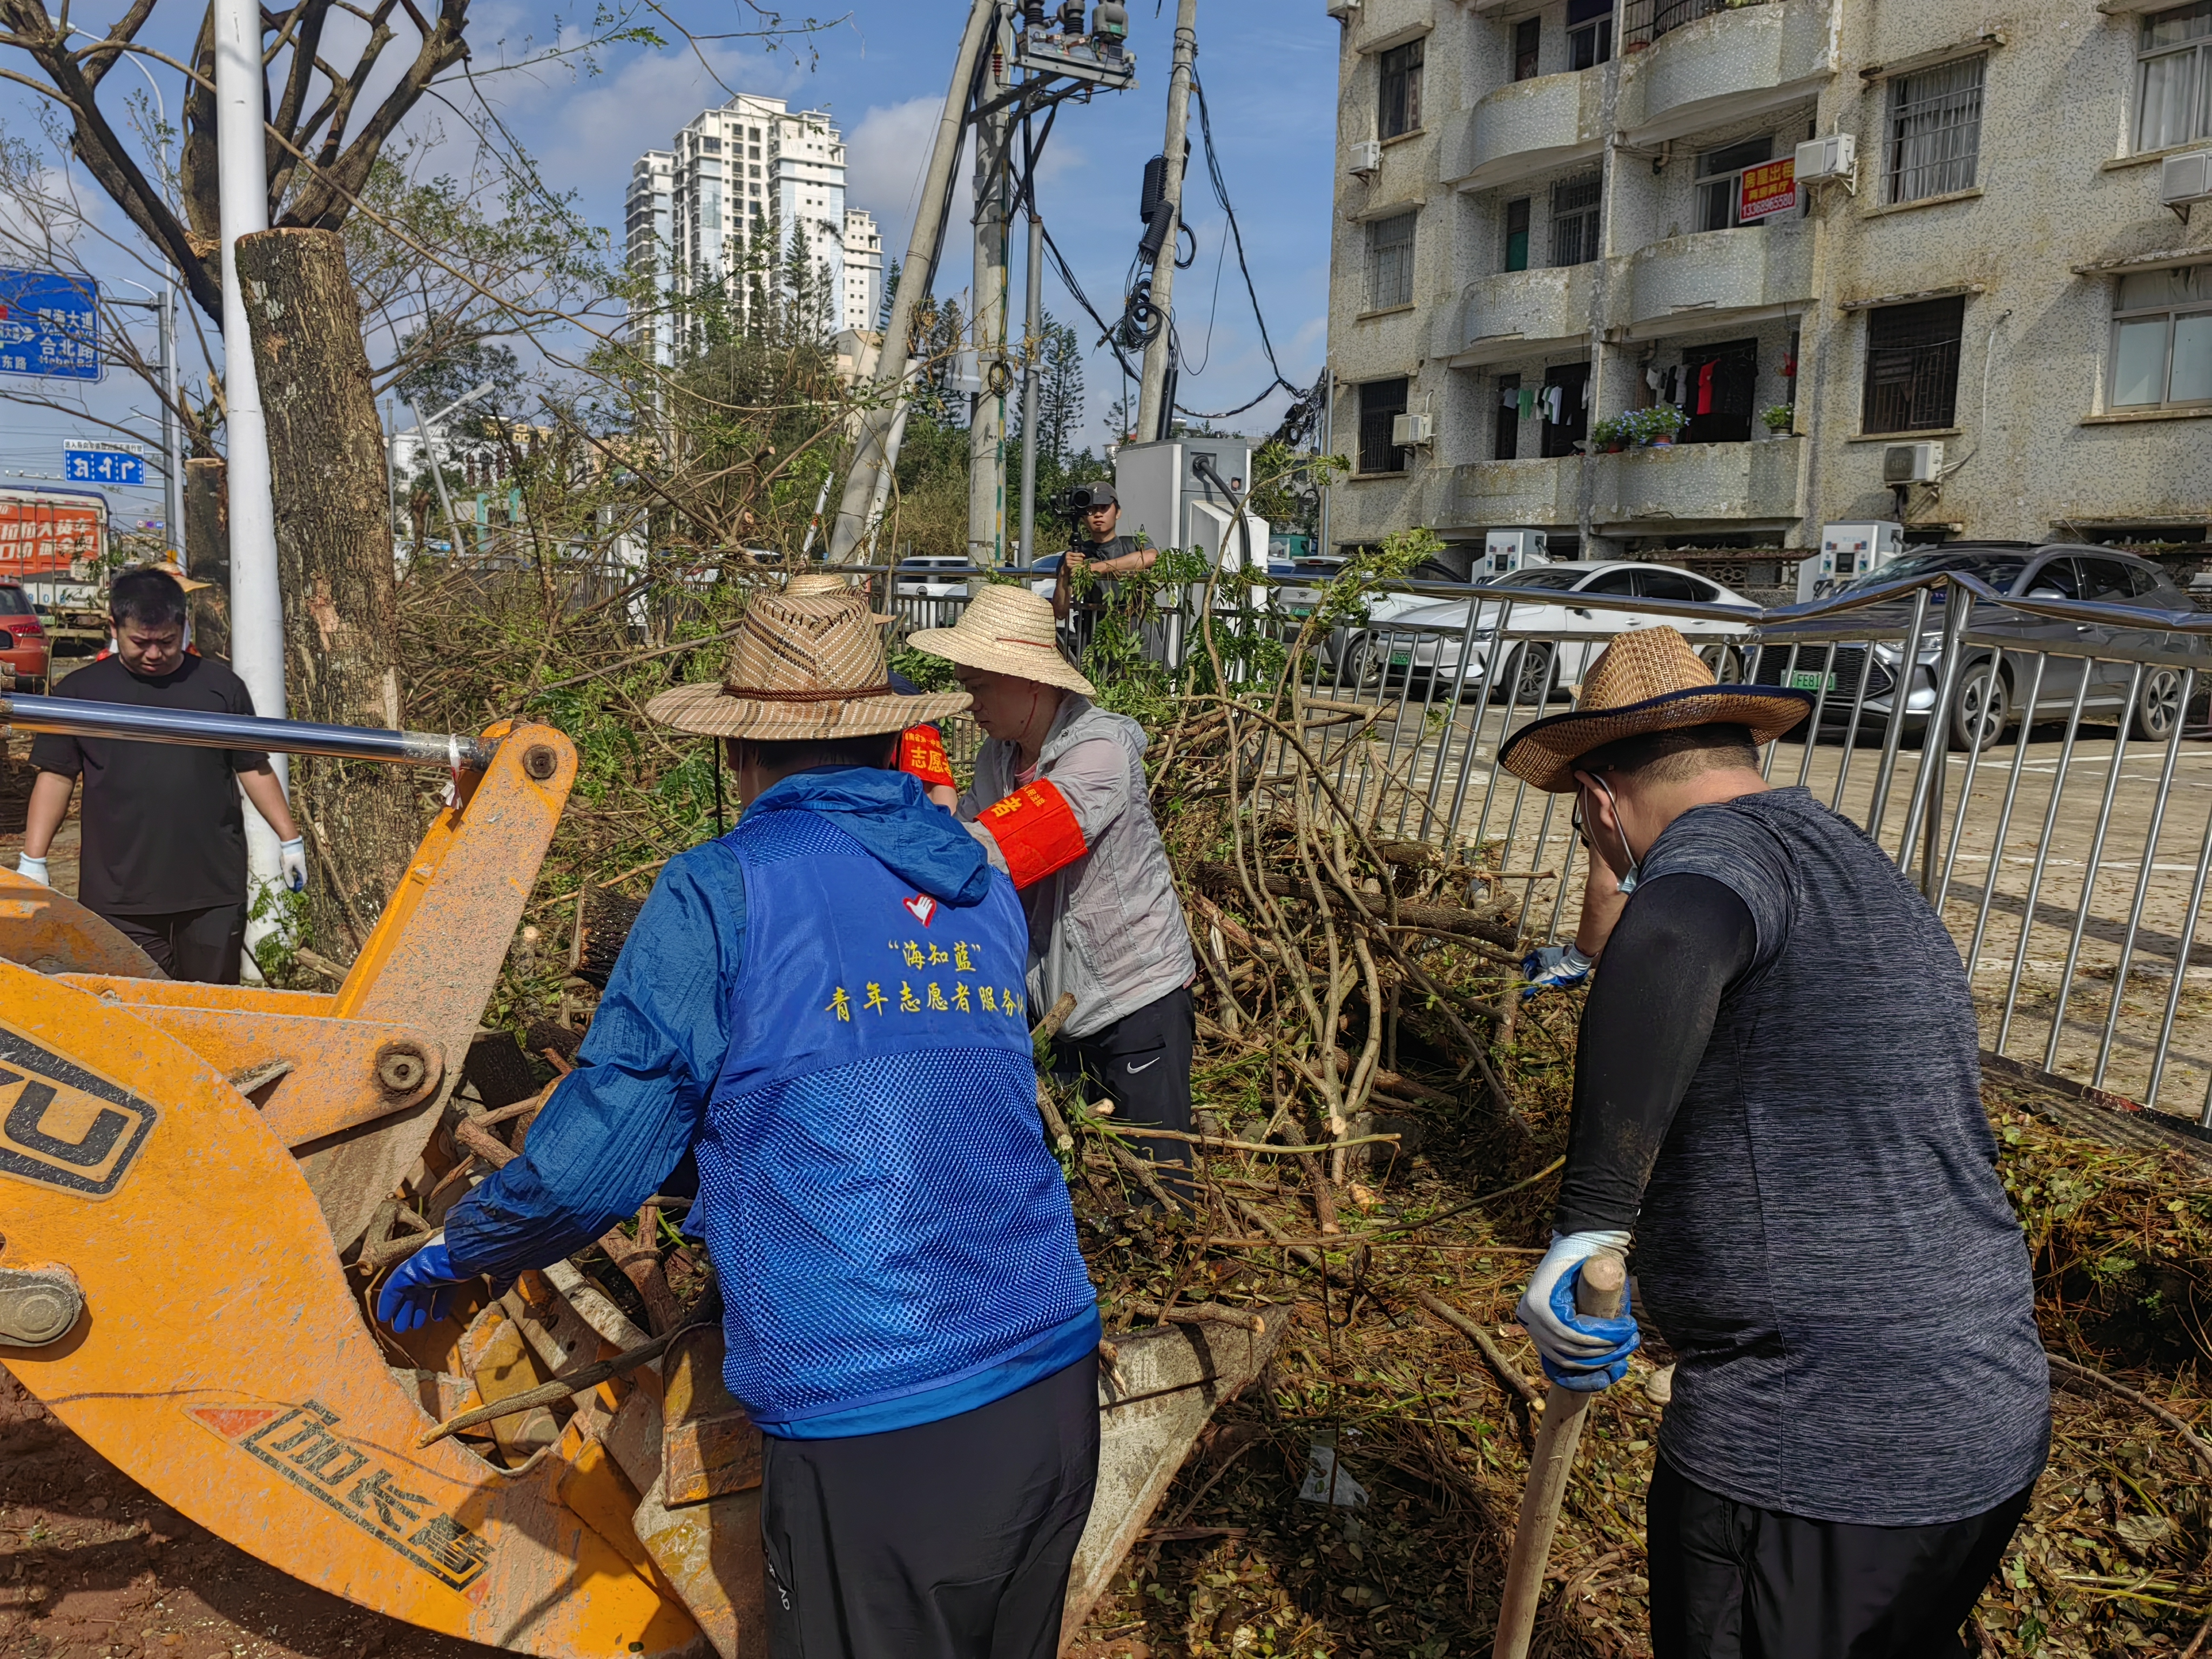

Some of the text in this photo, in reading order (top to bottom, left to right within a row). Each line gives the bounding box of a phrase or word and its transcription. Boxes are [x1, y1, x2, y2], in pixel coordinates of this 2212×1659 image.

[1744, 161, 1793, 189] 房屋出租
[1749, 180, 1789, 201] 两房两厅
[990, 797, 1022, 817] 者
